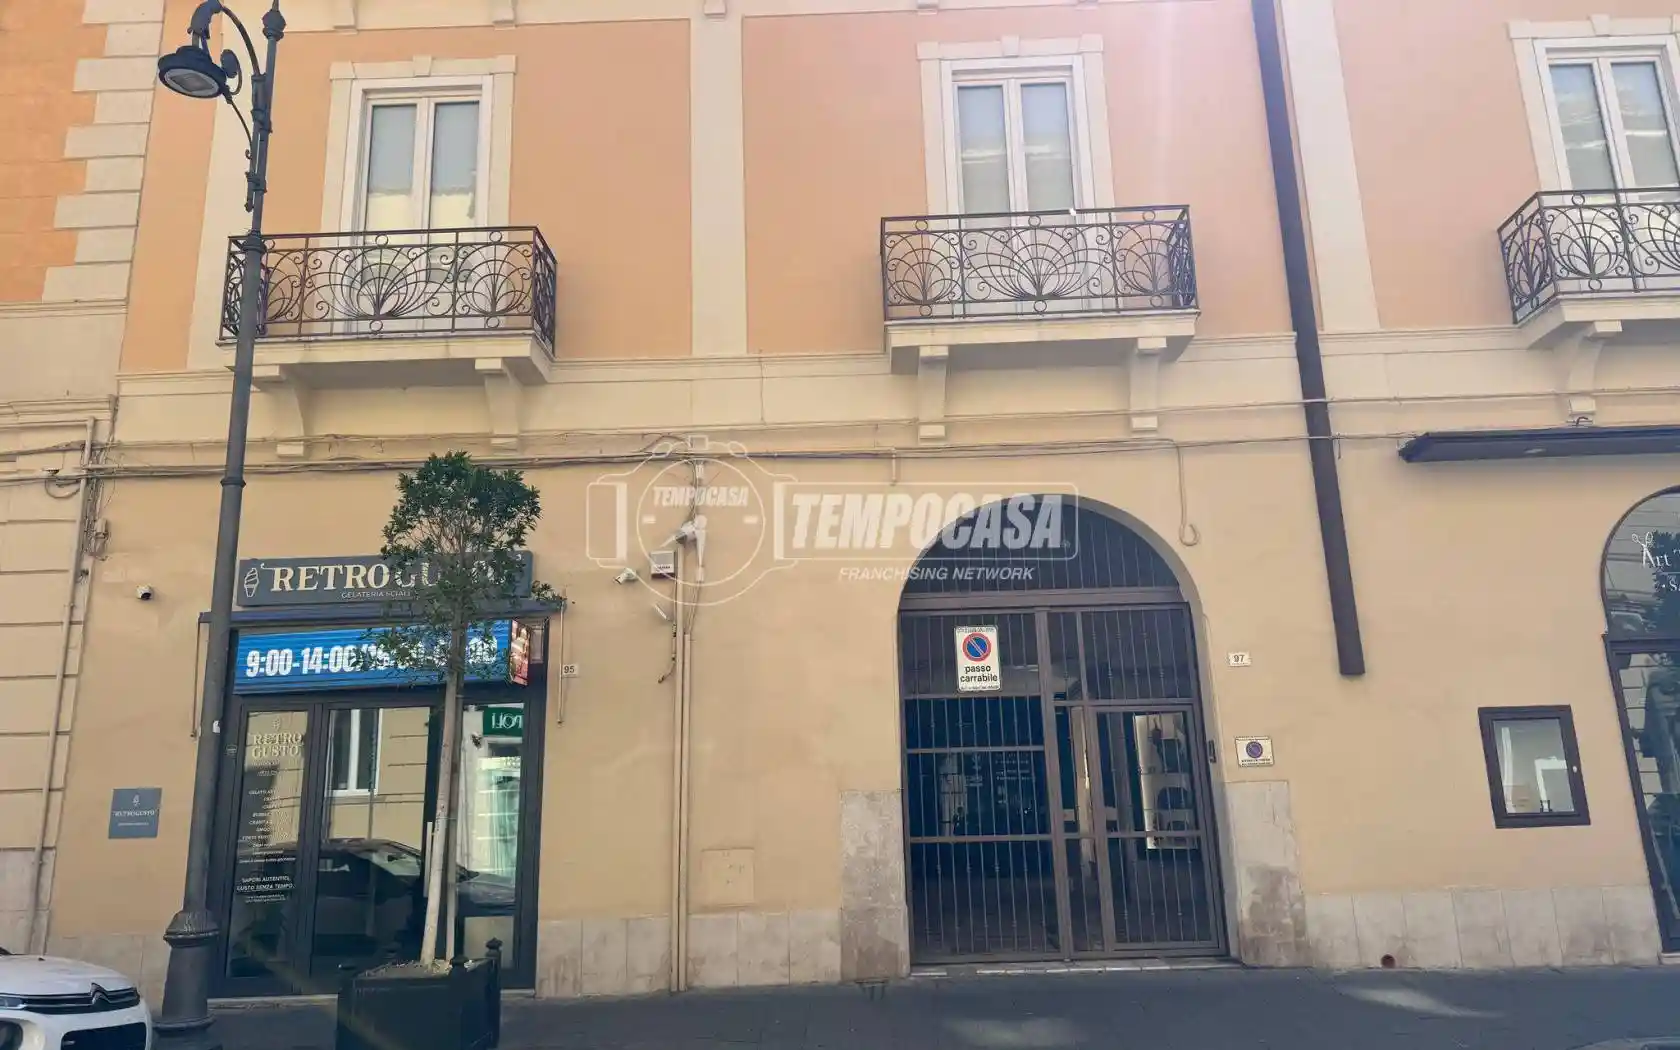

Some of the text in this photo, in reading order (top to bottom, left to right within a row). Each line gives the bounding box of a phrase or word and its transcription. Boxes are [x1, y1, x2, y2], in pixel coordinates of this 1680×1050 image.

[1233, 654, 1245, 663] 97
[563, 665, 575, 674] 95
[964, 665, 991, 674] passo
[960, 674, 998, 683] carrabile
